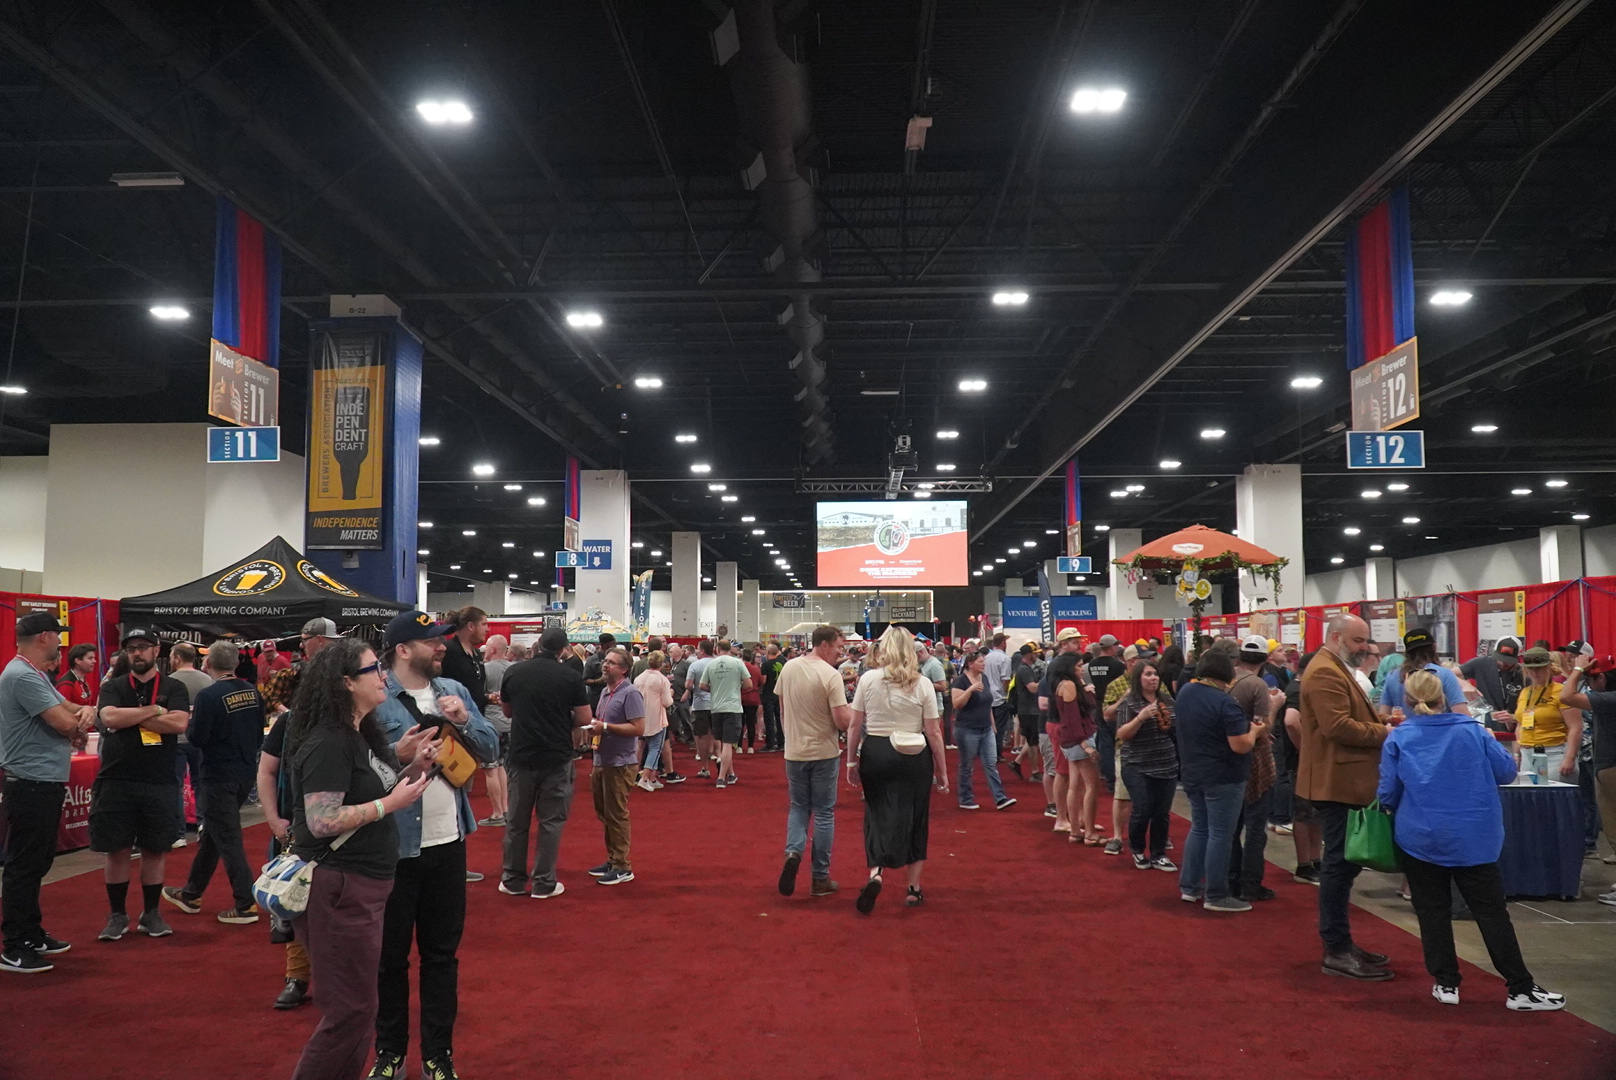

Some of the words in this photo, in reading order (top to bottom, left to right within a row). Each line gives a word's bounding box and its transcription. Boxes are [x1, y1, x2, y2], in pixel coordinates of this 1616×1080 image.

[215, 350, 234, 369] Meet
[244, 364, 270, 385] Brewer
[1355, 372, 1372, 390] Meet
[1381, 355, 1407, 376] Brewer
[1388, 372, 1407, 419] 12
[250, 383, 265, 425] 11
[336, 402, 364, 416] INDE
[323, 386, 332, 446] ASSOCIATION
[335, 416, 360, 429] PEN
[335, 429, 367, 442] DENT
[235, 431, 257, 458] 11
[334, 442, 365, 451] CRAFT
[1376, 435, 1405, 464] 12
[321, 447, 330, 493] BREWERS
[313, 517, 379, 528] INDEPENDENCE
[340, 530, 379, 540] MATTERS
[583, 545, 611, 553] WATER
[570, 553, 577, 566] 8
[1072, 558, 1080, 572] 9
[154, 606, 190, 615] BRISTOL
[193, 606, 237, 615] BREWING
[239, 606, 287, 615] COMPANY
[341, 607, 360, 616] BRISTOL
[360, 607, 380, 616] BREWING
[380, 608, 399, 617] COMPANY
[226, 692, 256, 706] DANVILLE
